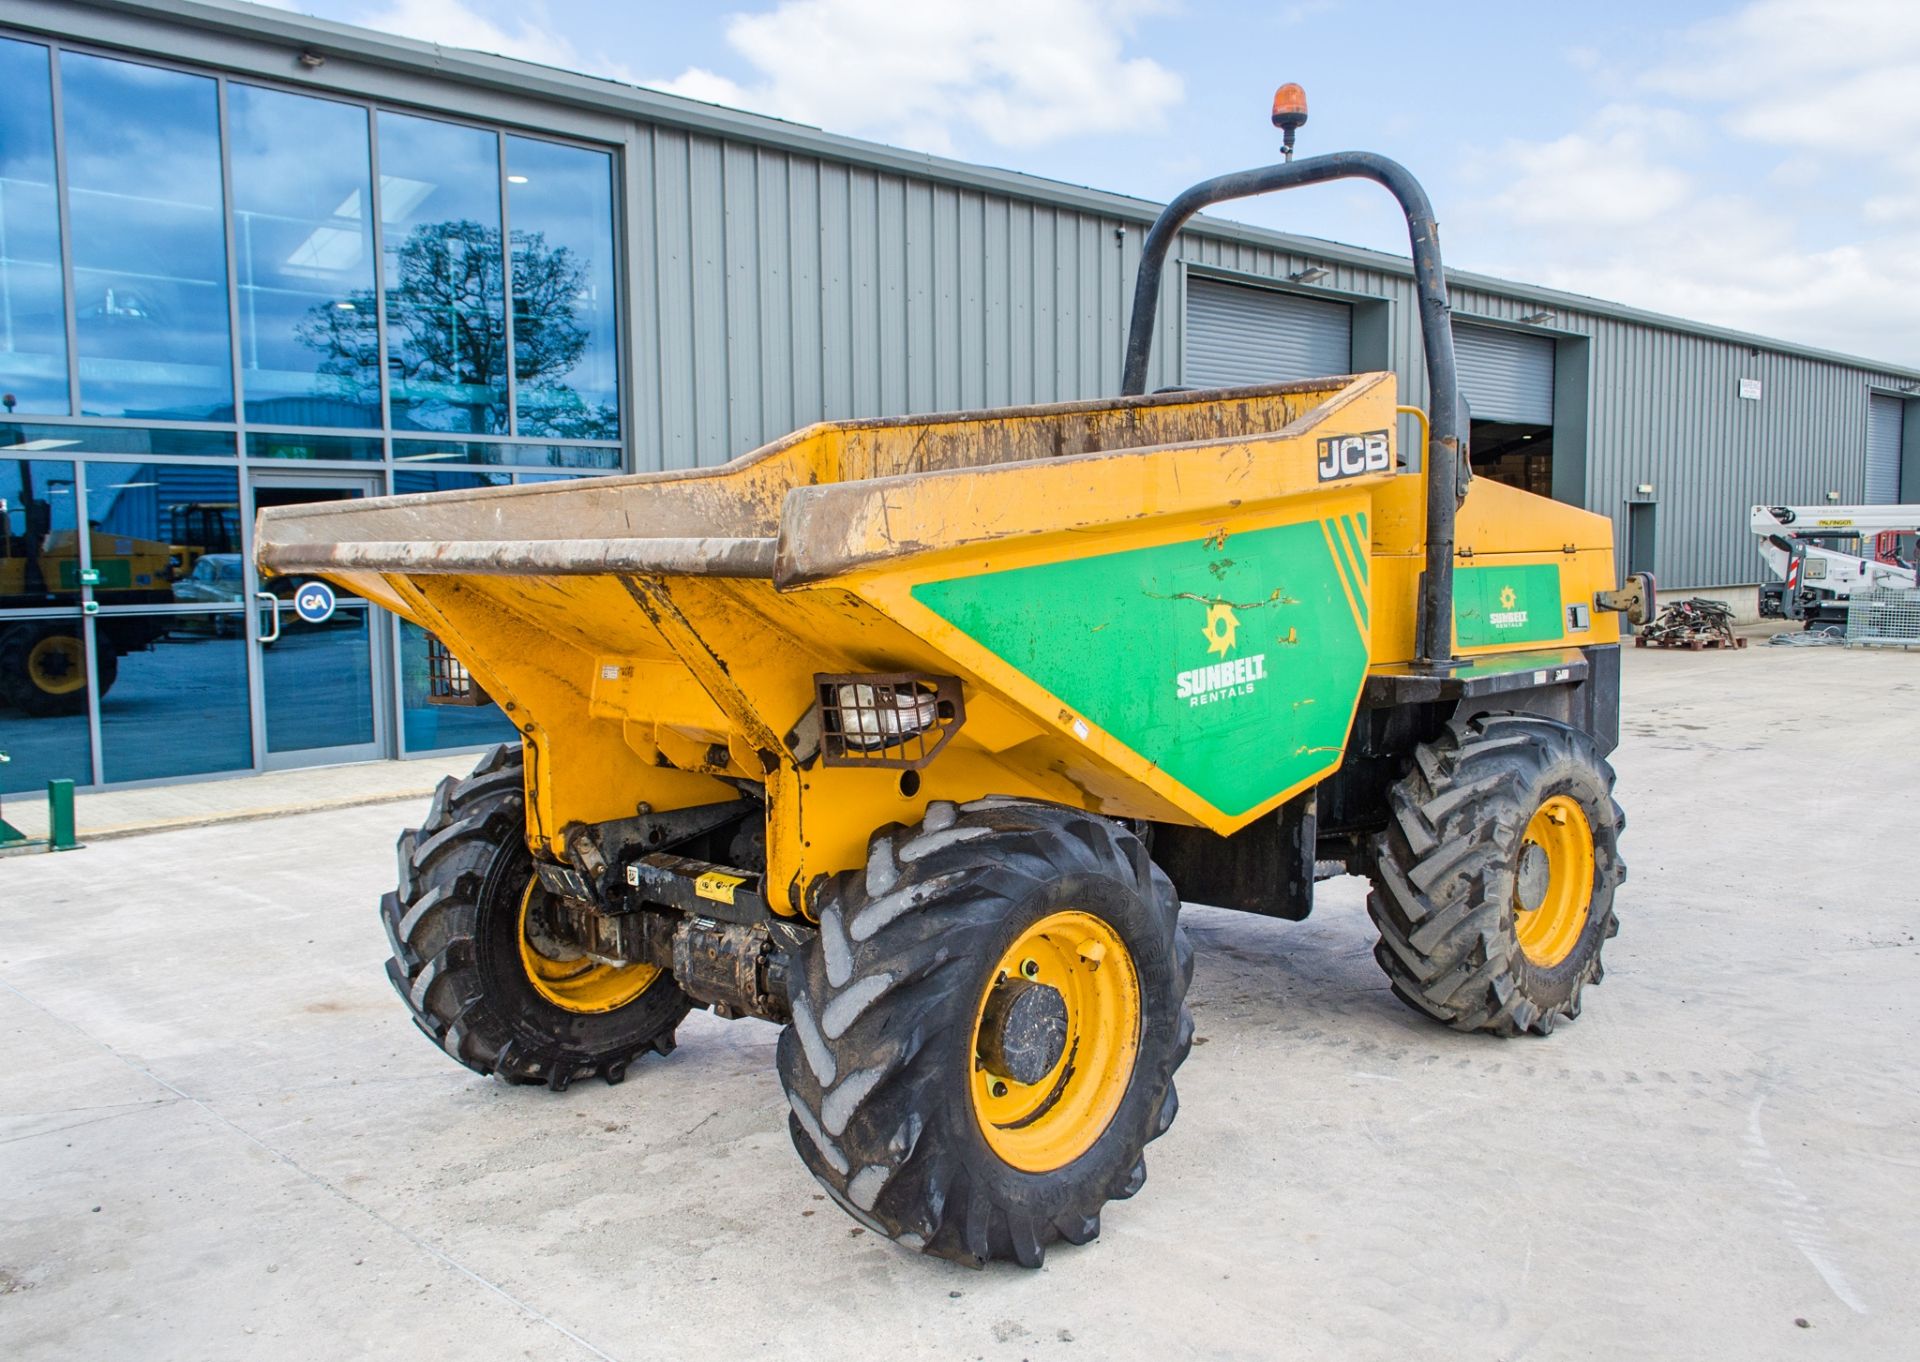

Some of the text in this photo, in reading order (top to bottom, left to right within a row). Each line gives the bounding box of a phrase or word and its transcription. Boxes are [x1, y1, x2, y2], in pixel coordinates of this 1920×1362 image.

[1319, 433, 1389, 478] JCB
[301, 594, 328, 610] GA
[1490, 611, 1528, 624] SUNBELT
[1176, 653, 1265, 699] SUNBELT
[1190, 682, 1255, 708] RENTALS
